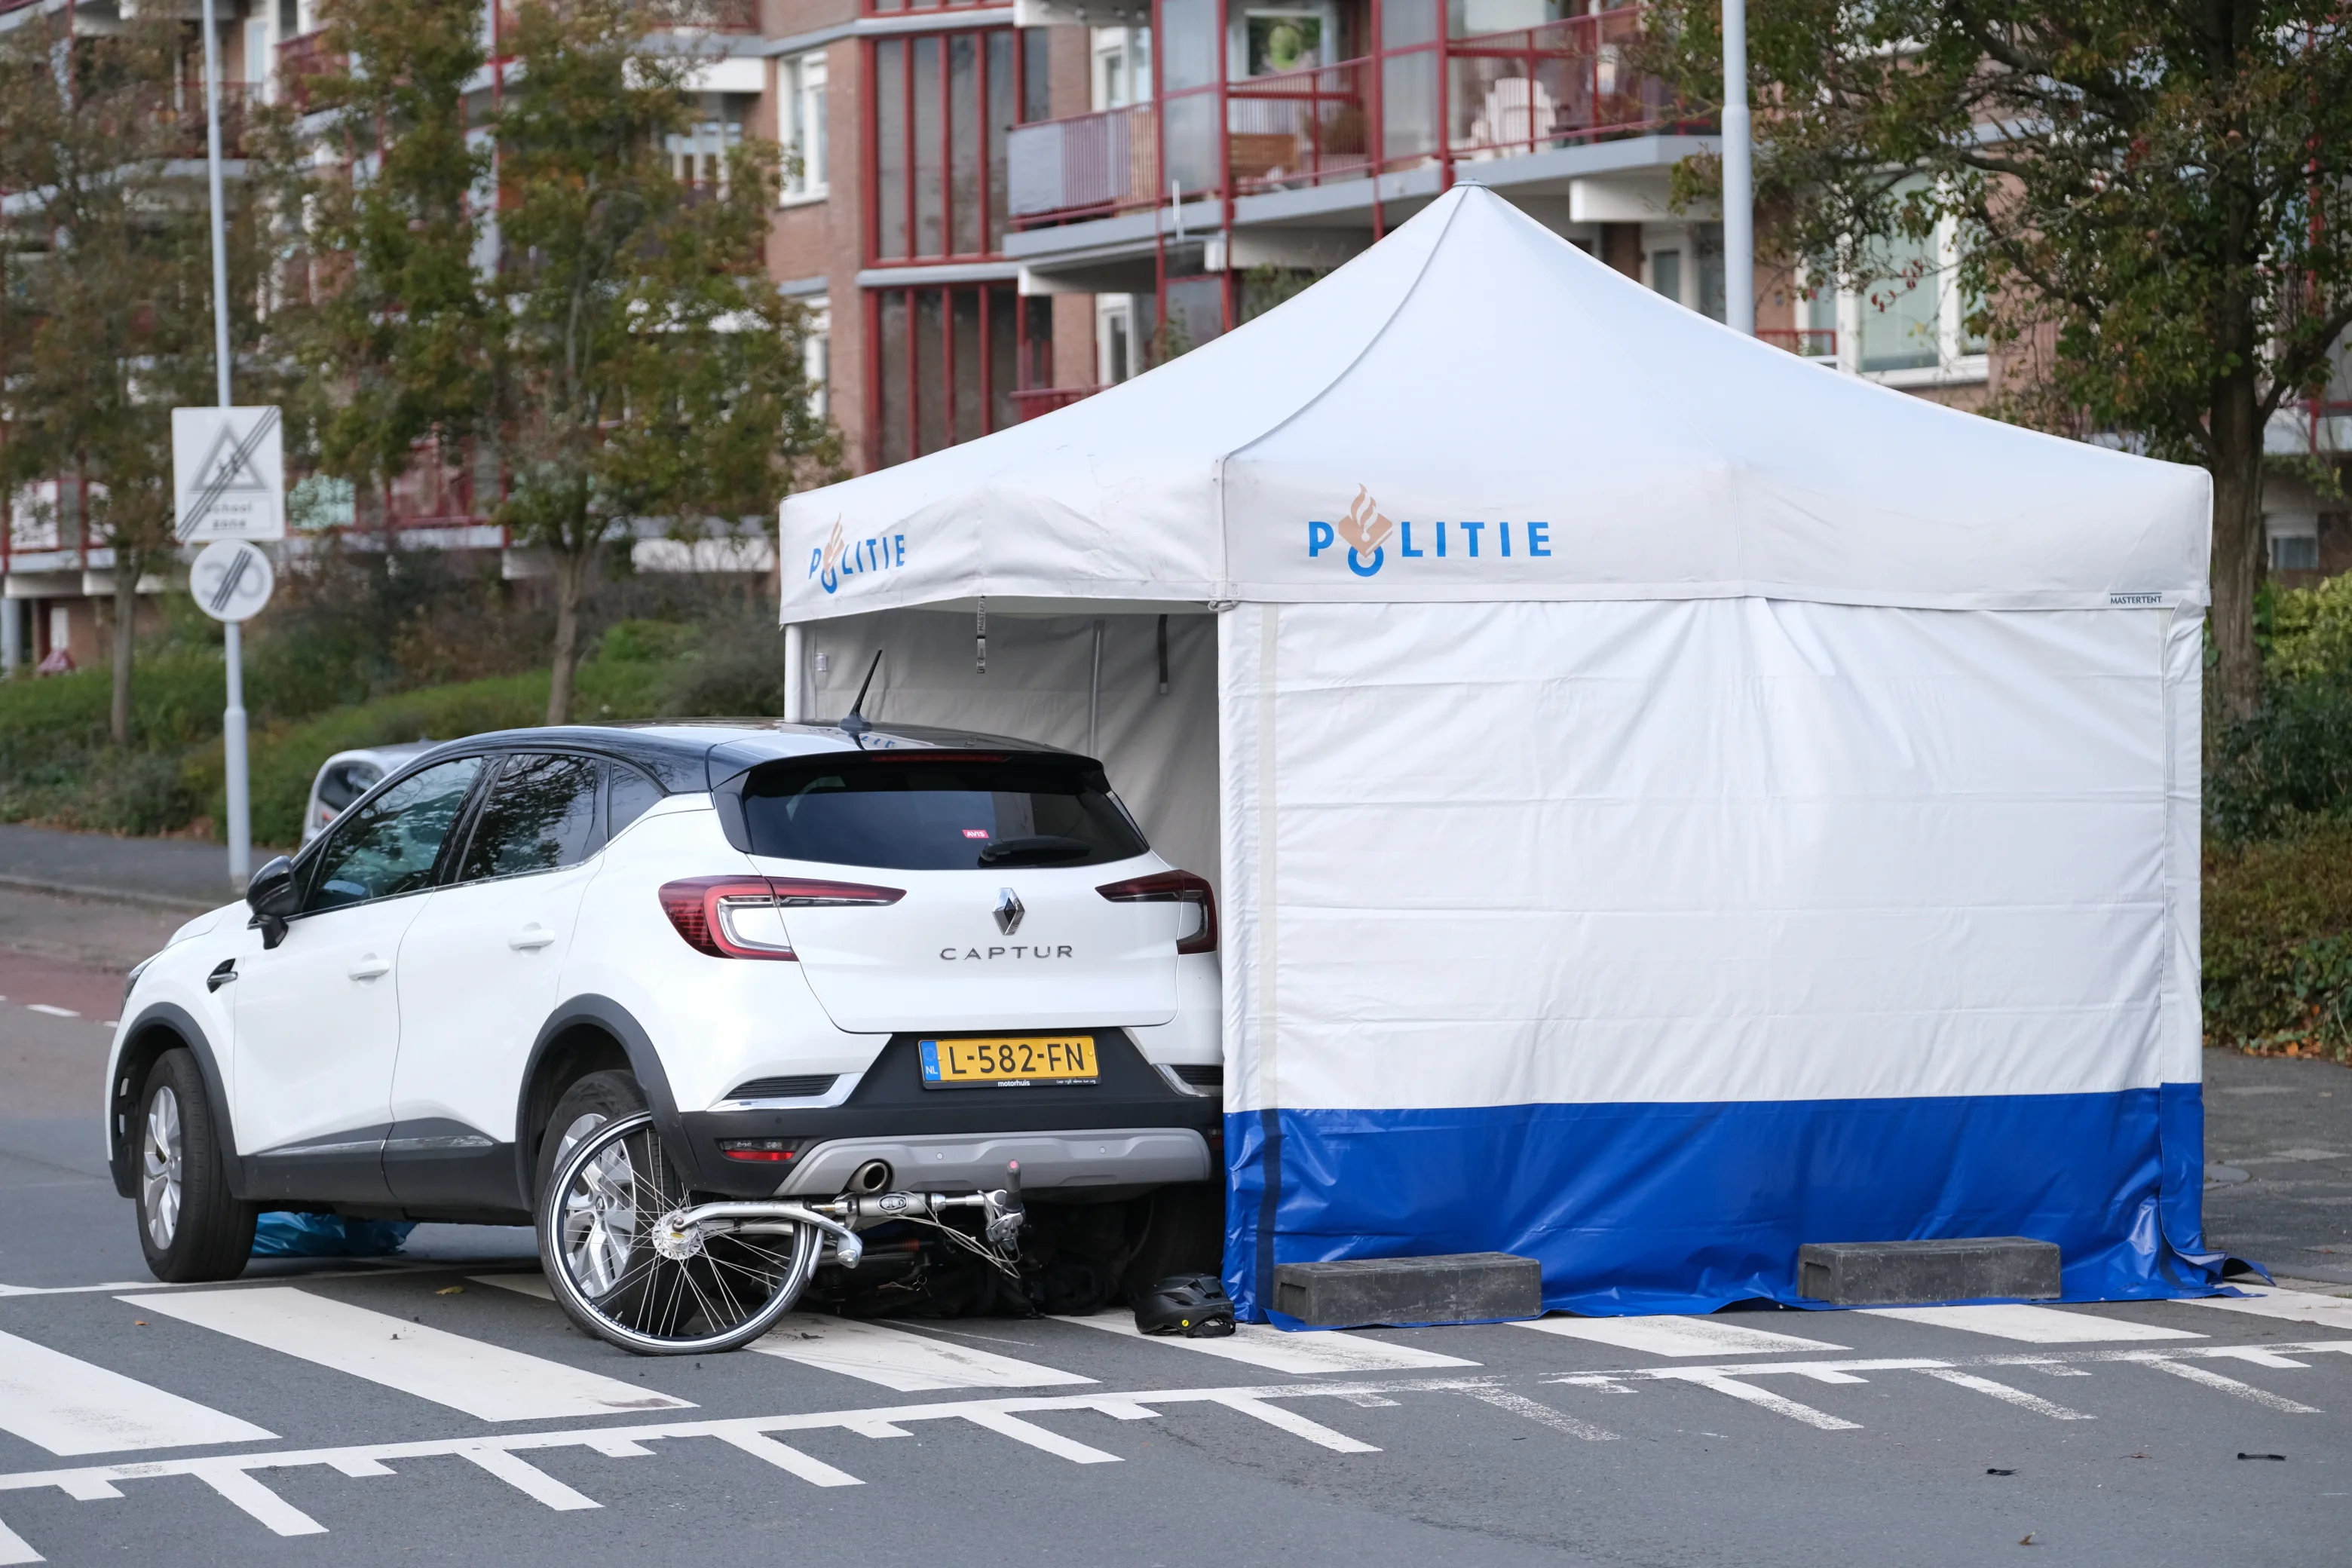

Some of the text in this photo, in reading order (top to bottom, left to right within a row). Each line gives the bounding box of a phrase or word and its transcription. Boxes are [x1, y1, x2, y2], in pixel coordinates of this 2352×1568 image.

[808, 534, 905, 594] POLITIE
[1309, 521, 1552, 577] POLITIE
[201, 560, 265, 600] 30
[2110, 596, 2162, 605] MASTERTENT
[939, 945, 1073, 961] CAPTUR
[926, 1065, 939, 1075] NL
[948, 1043, 1086, 1075] L-582-FN
